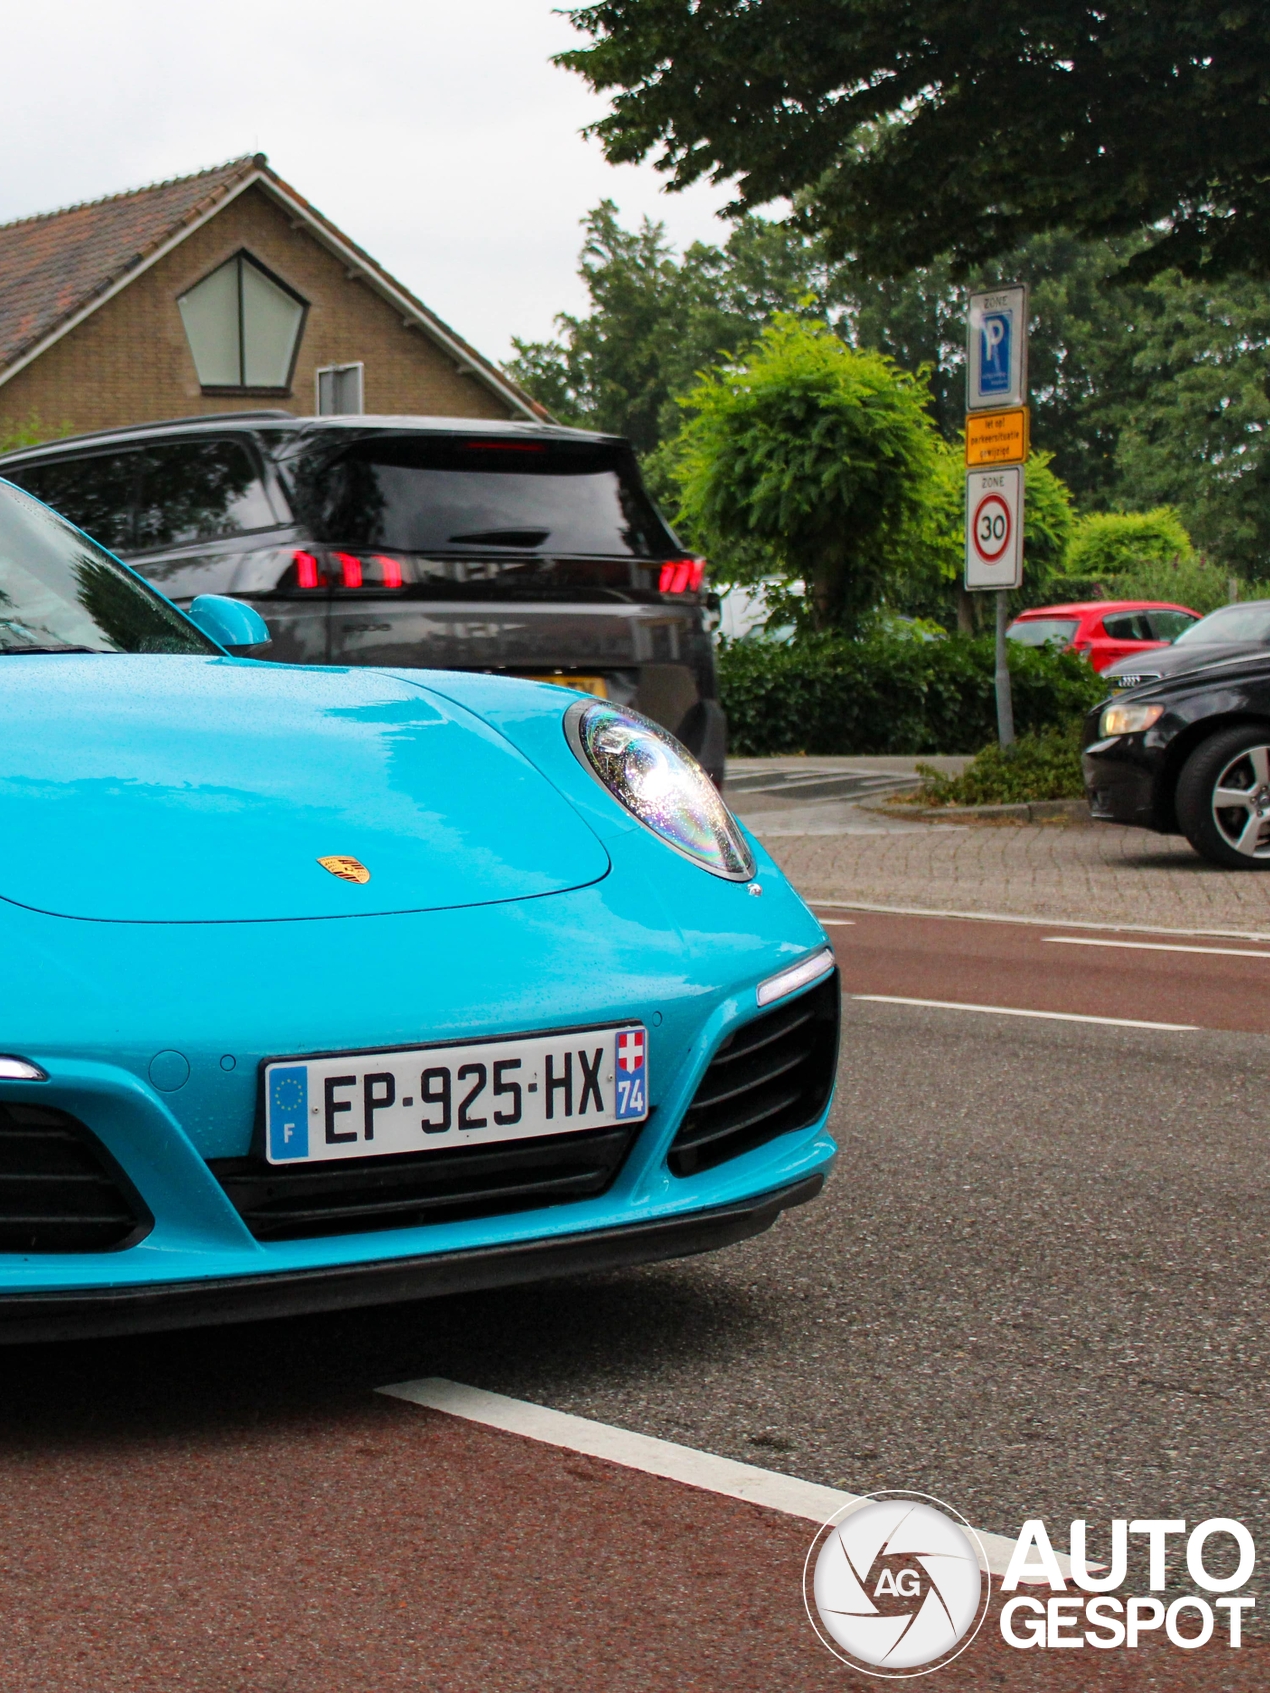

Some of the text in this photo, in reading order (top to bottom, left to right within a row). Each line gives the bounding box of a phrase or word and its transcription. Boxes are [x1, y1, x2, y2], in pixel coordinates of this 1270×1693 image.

[983, 295, 1008, 308] ZONE
[982, 477, 1005, 489] ZONE
[980, 514, 1005, 541] 30
[283, 1047, 644, 1145] F EP-925-HX 74
